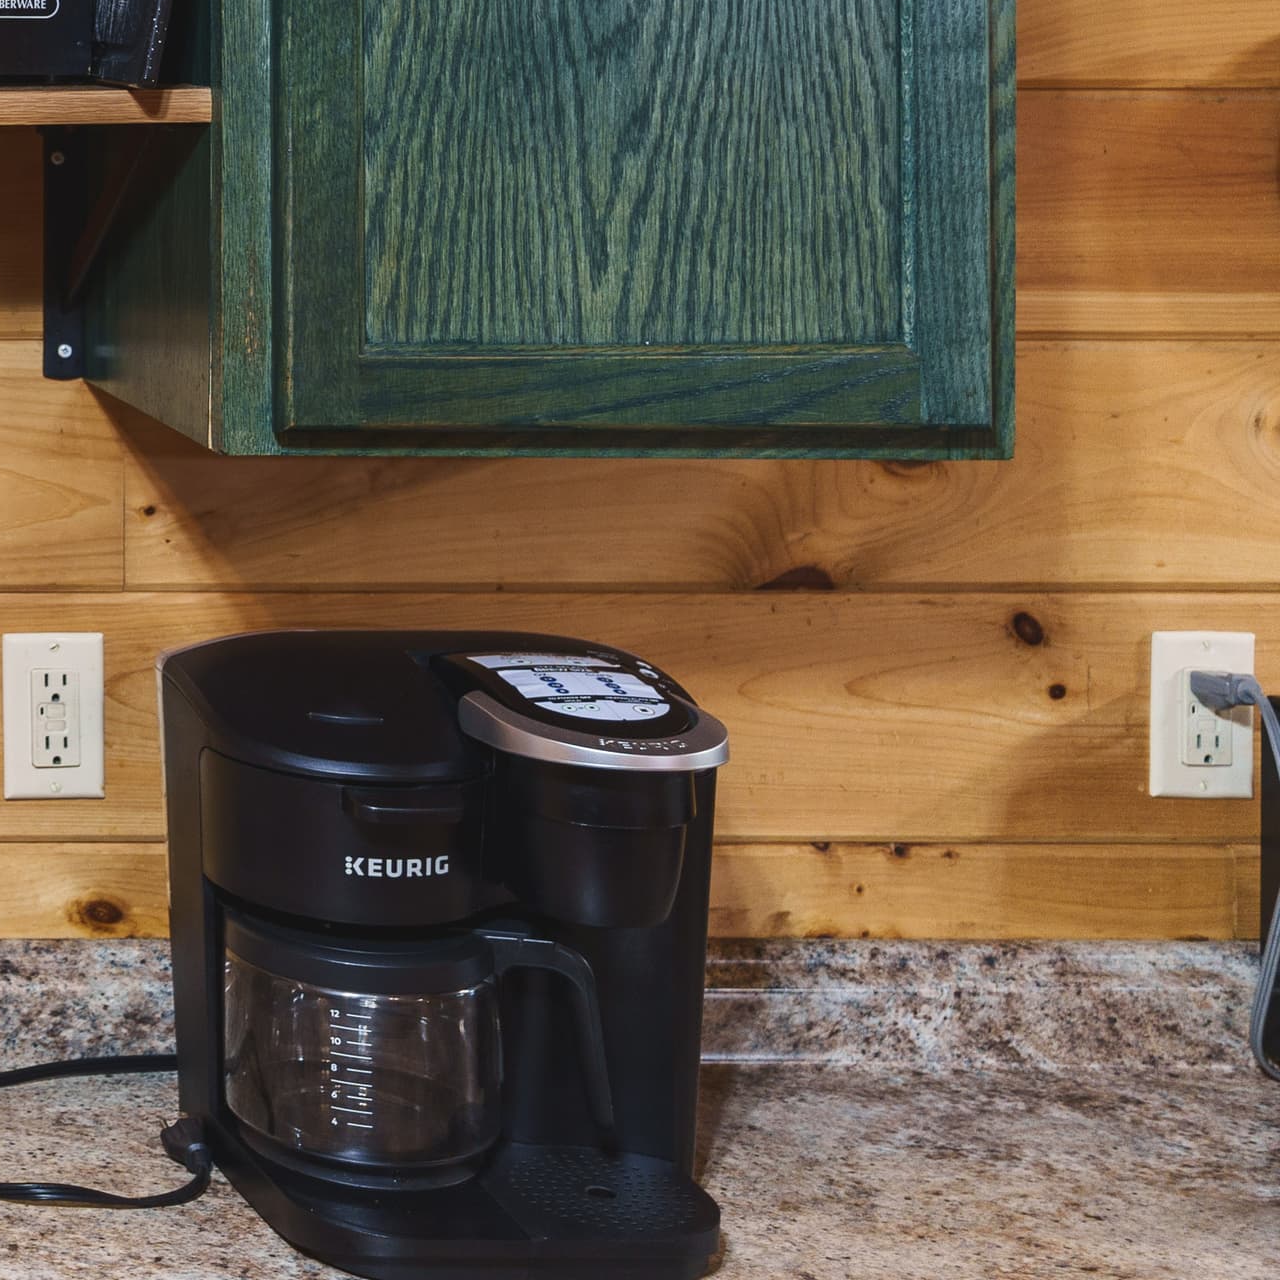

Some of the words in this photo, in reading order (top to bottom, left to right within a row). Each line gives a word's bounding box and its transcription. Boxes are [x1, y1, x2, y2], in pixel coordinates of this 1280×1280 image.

[345, 855, 449, 878] KEURIG
[329, 1009, 340, 1018] 12
[330, 1036, 342, 1046] 10
[330, 1063, 338, 1072] 8
[331, 1090, 338, 1099] 6
[331, 1117, 338, 1126] 4
